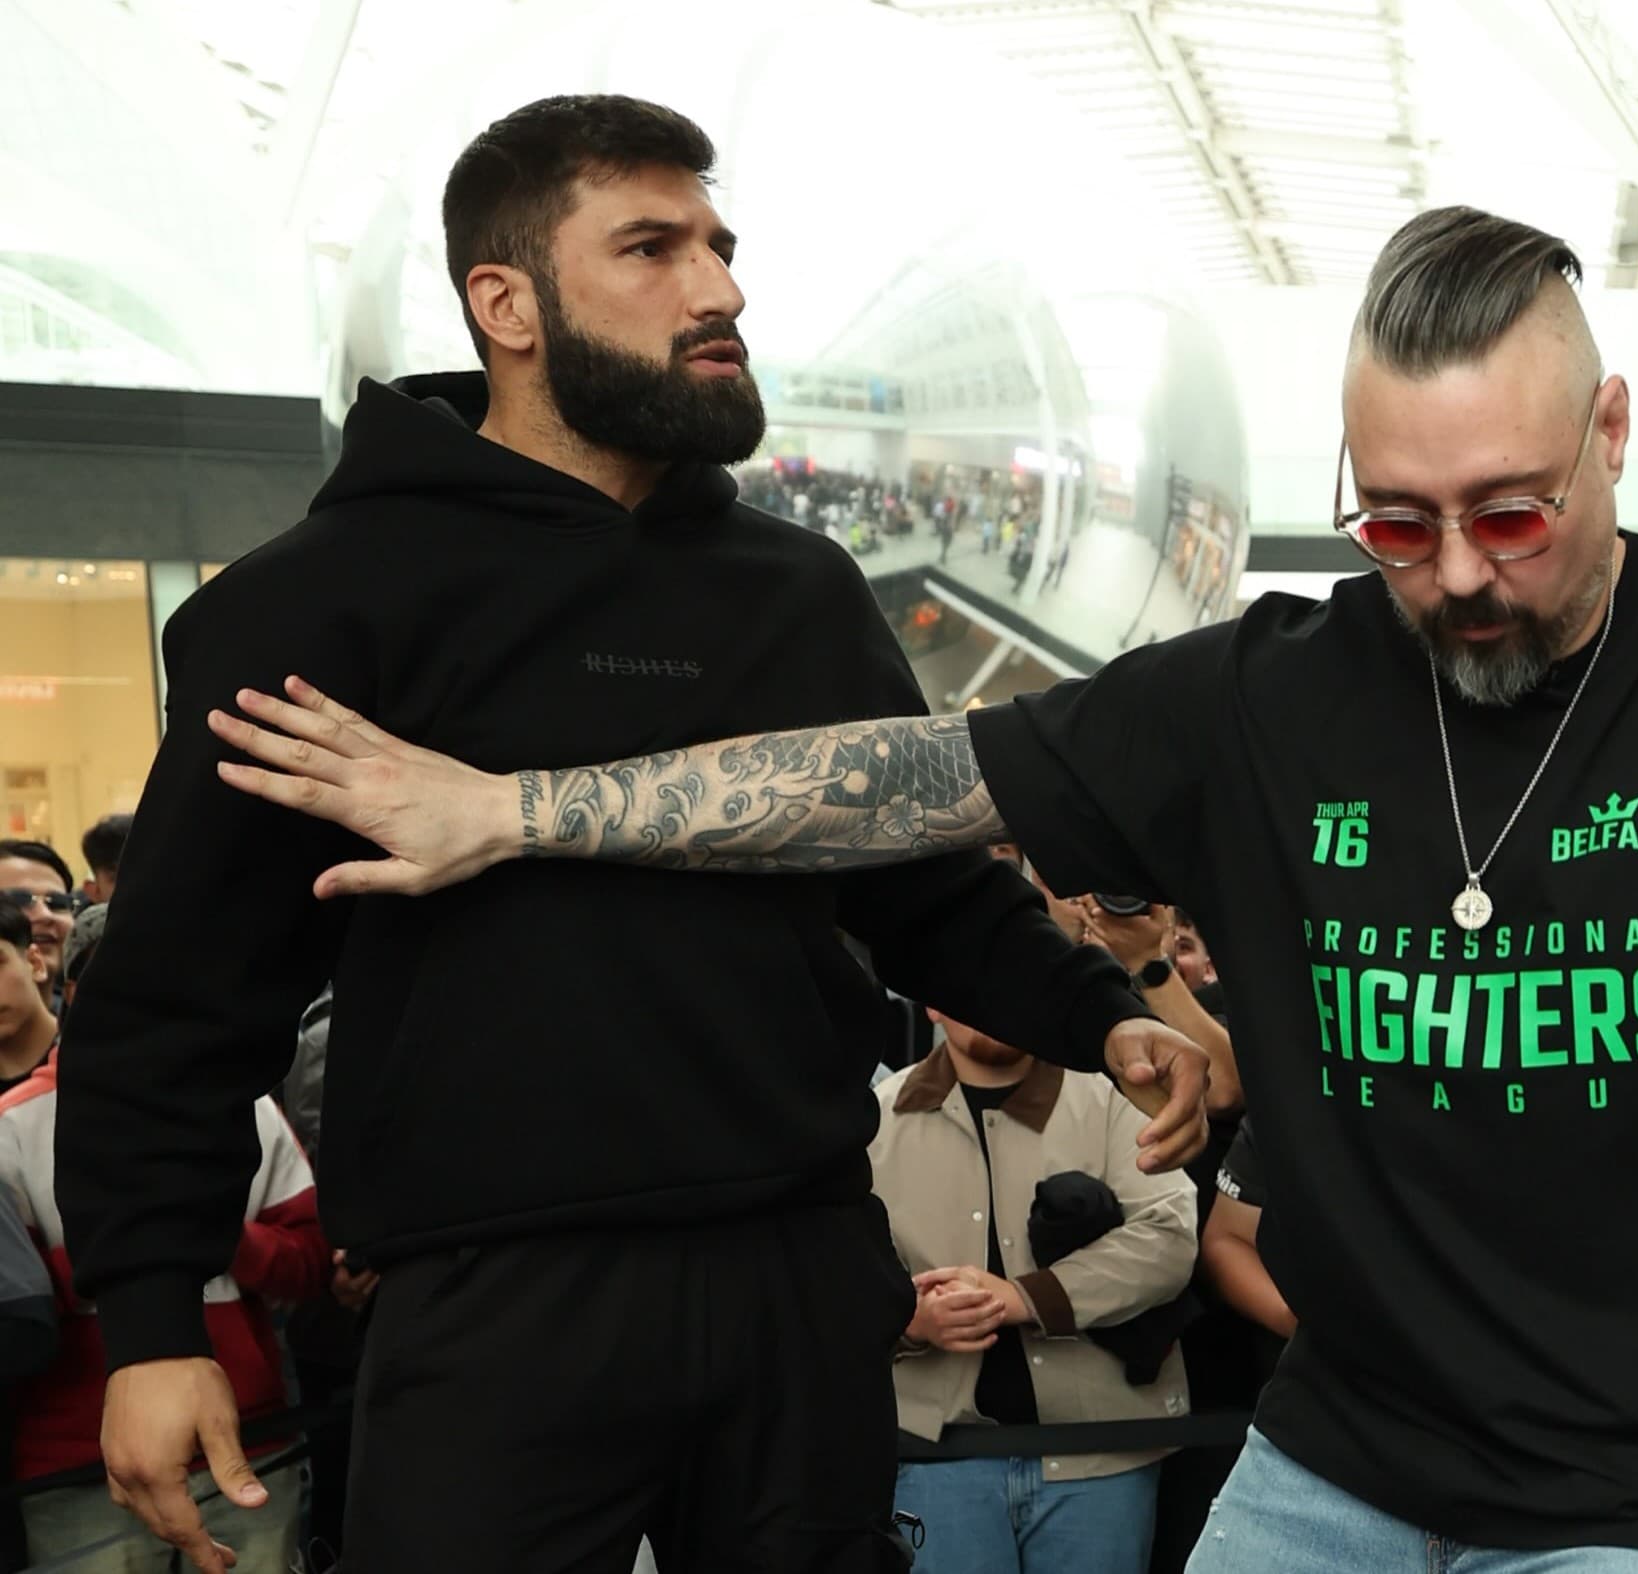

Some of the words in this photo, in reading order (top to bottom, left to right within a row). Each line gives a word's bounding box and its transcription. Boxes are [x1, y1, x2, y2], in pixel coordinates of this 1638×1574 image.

[1317, 801, 1345, 818] THUR
[1347, 801, 1369, 817] APR
[1313, 818, 1369, 867] 16
